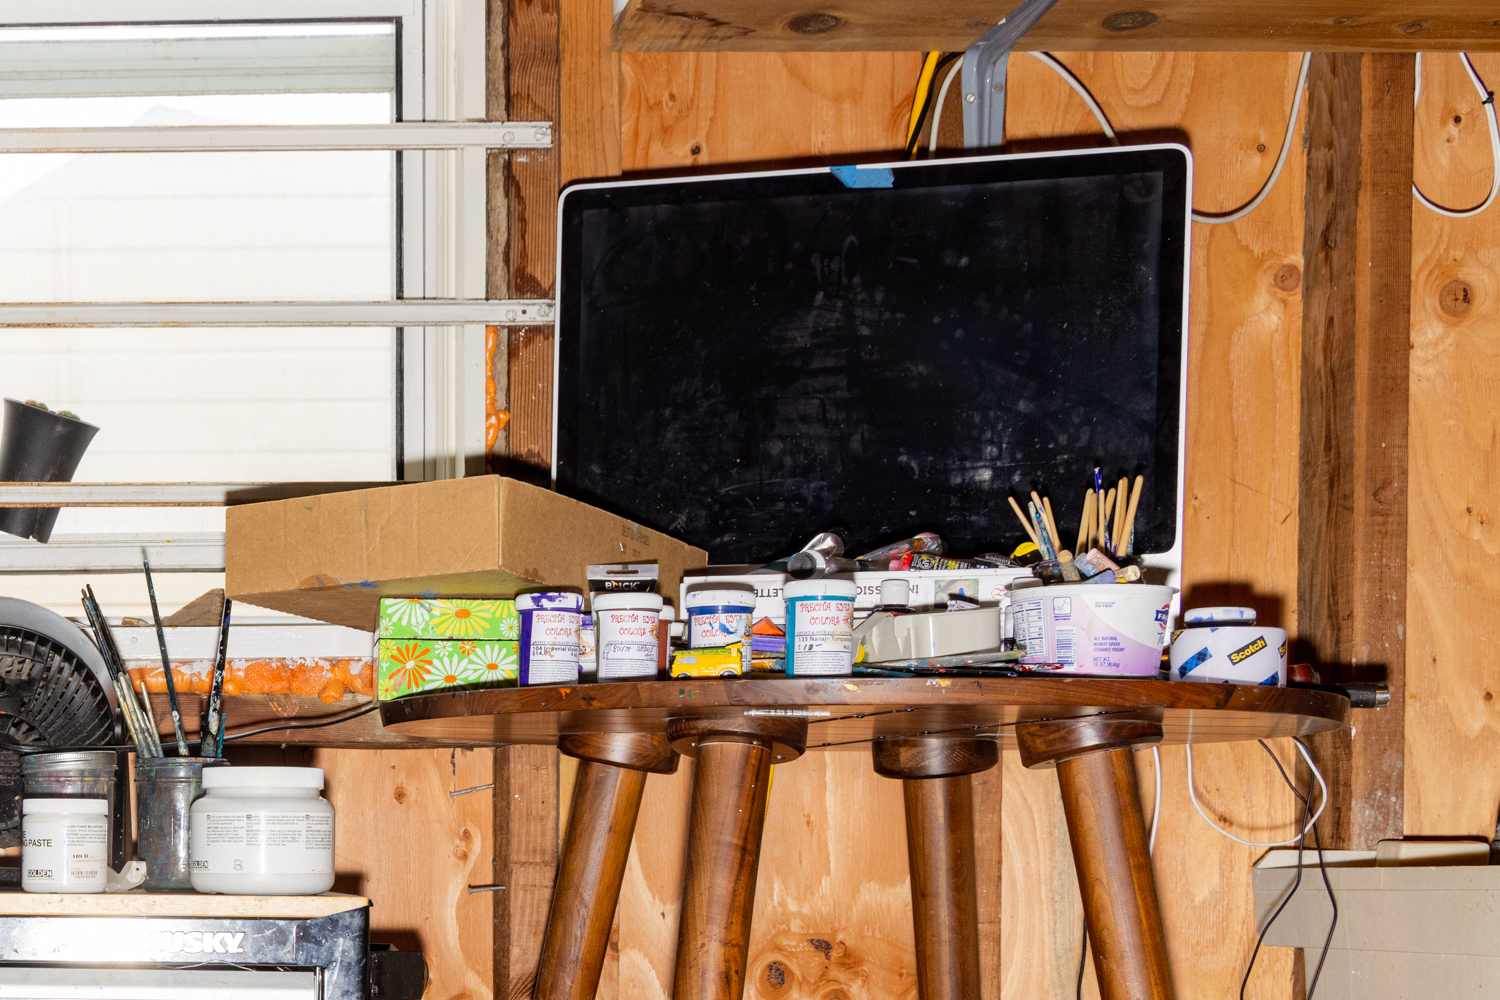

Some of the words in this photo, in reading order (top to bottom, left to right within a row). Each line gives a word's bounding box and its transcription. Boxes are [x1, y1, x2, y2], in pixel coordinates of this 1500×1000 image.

[604, 582, 638, 591] BLICK
[800, 602, 831, 613] PRECITA
[835, 602, 850, 612] EYES
[610, 614, 639, 624] PRECITA
[642, 616, 656, 624] EYES
[810, 616, 840, 626] COLORS
[545, 628, 572, 637] COLORS
[619, 627, 646, 636] COLORS
[1231, 639, 1266, 663] Scotch
[28, 839, 52, 848] PASTE
